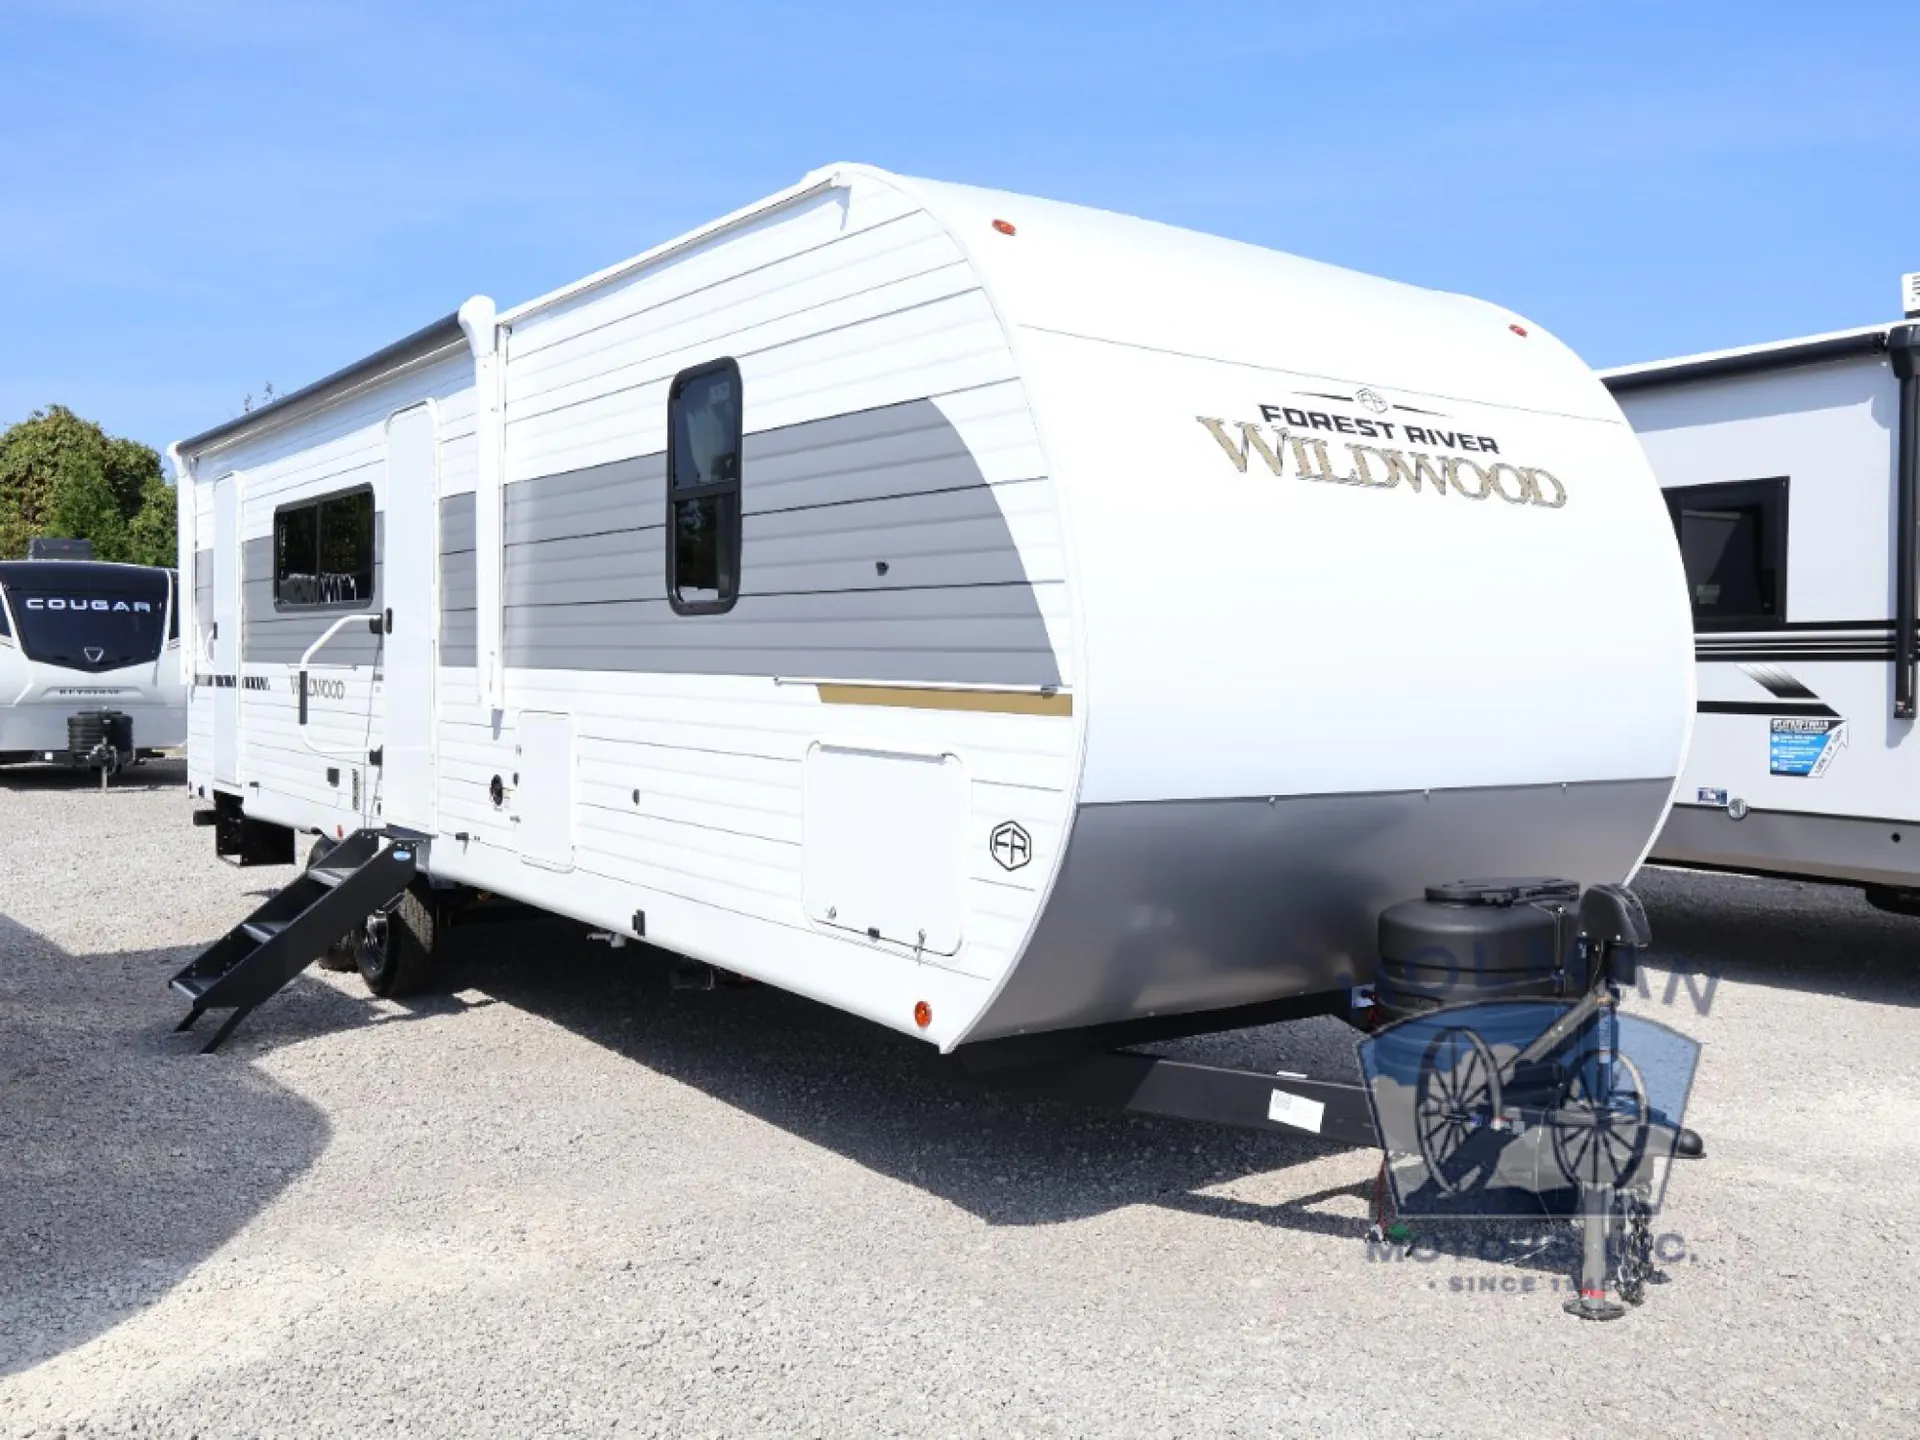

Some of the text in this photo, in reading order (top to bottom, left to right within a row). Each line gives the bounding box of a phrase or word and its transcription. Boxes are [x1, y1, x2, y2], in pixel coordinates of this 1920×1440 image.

[1259, 404, 1501, 454] FOREST RIVER
[1196, 415, 1568, 509] WILDWOOD
[26, 597, 151, 613] COUGAR
[290, 675, 345, 700] WDWOOD
